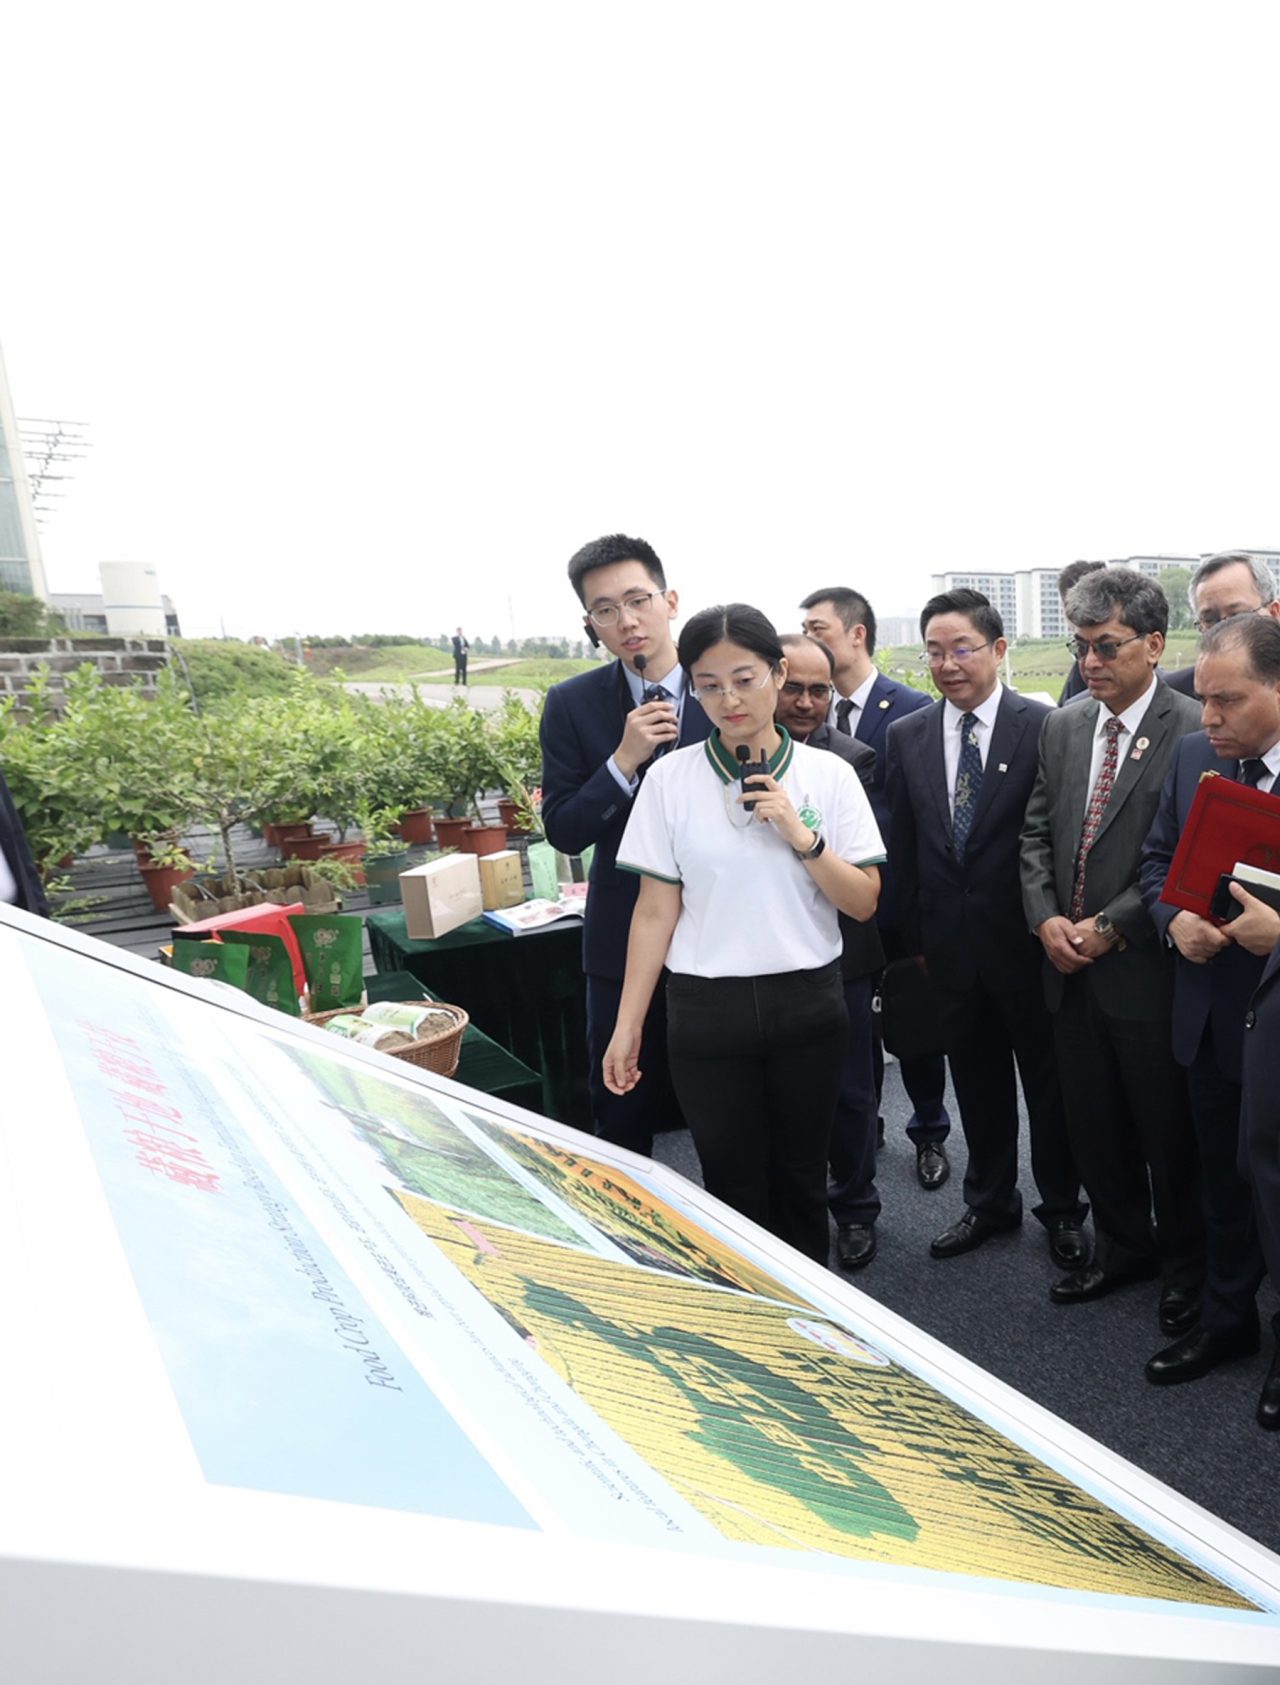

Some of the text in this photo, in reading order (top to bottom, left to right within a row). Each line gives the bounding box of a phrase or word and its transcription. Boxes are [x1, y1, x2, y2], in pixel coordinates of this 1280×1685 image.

[78, 1020, 168, 1096] 藏粮于技
[106, 1088, 222, 1194] 藏粮于地
[256, 1190, 297, 1237] Strategy
[283, 1235, 344, 1307] Production
[329, 1306, 369, 1345] Crop
[343, 1345, 403, 1392] Food
[651, 1343, 842, 1488] 中国梦
[776, 1347, 1126, 1564] 乡村振兴
